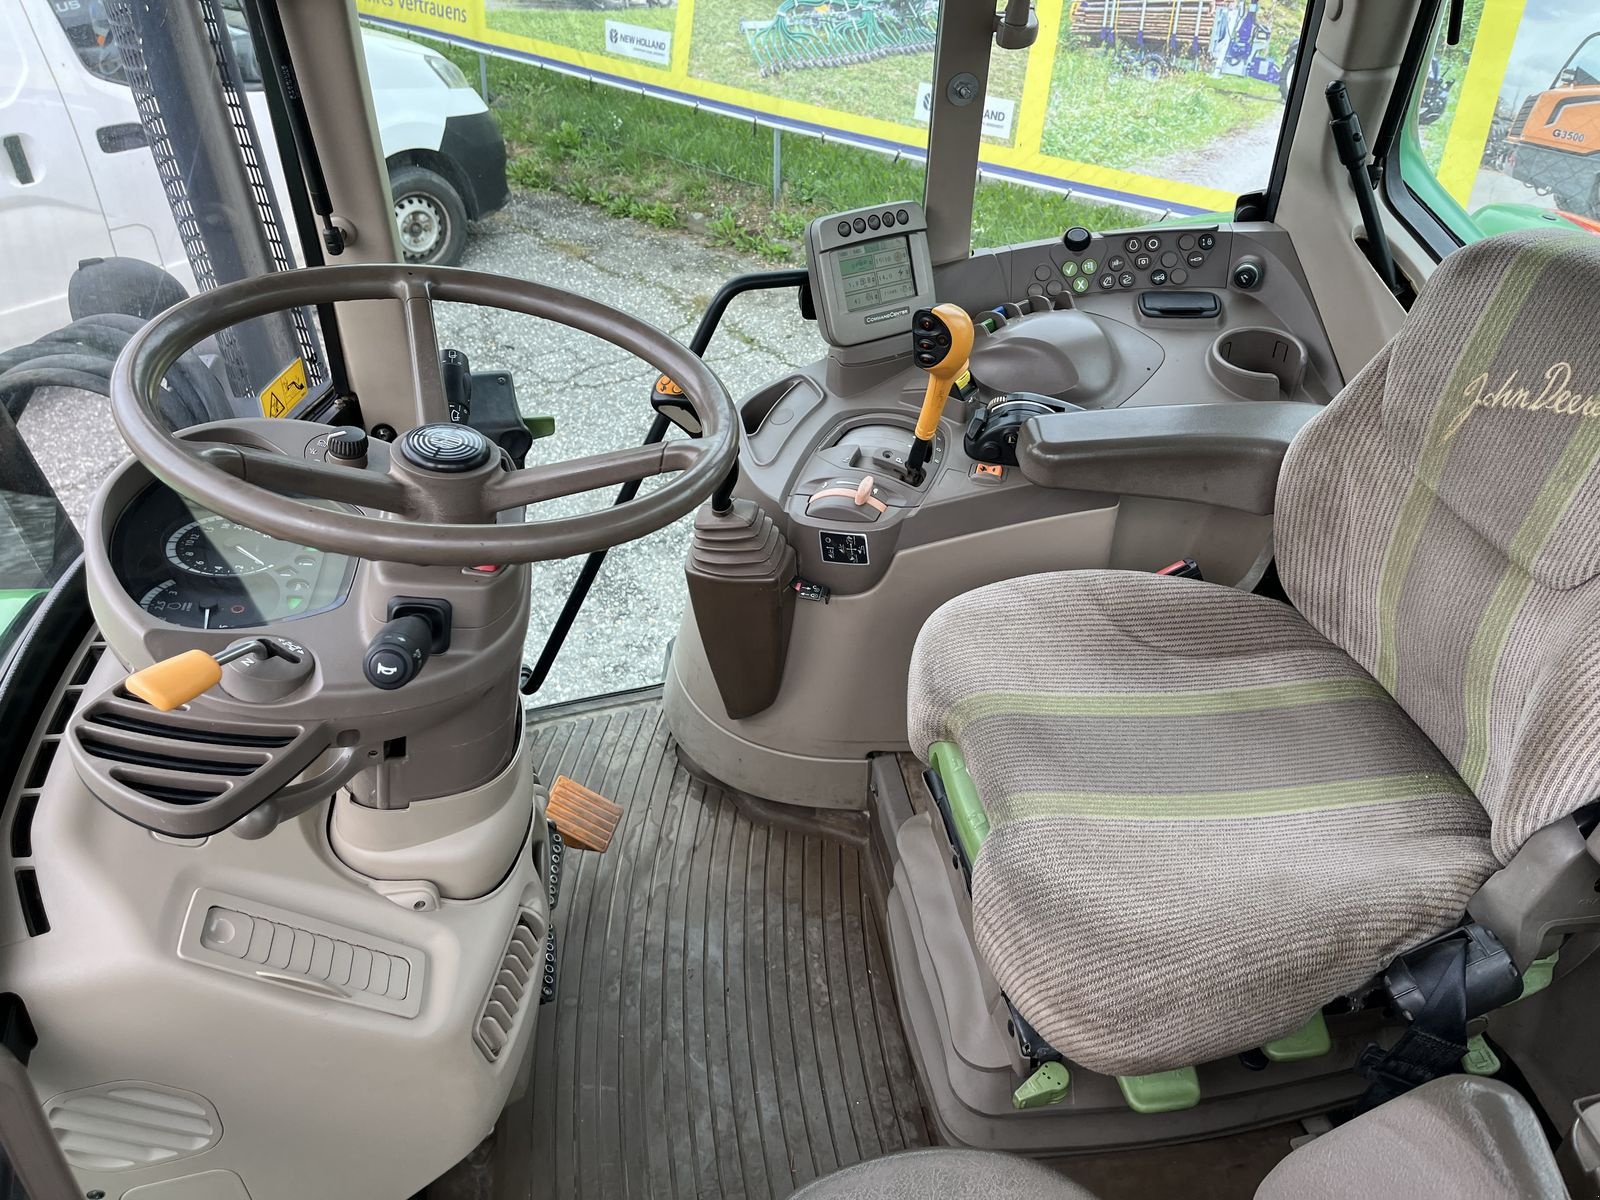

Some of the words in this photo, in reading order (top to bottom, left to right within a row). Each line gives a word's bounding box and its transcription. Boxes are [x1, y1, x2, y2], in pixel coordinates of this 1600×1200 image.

[619, 33, 635, 45] NEW
[635, 37, 666, 52] HOLLAND
[1552, 128, 1585, 143] G3500
